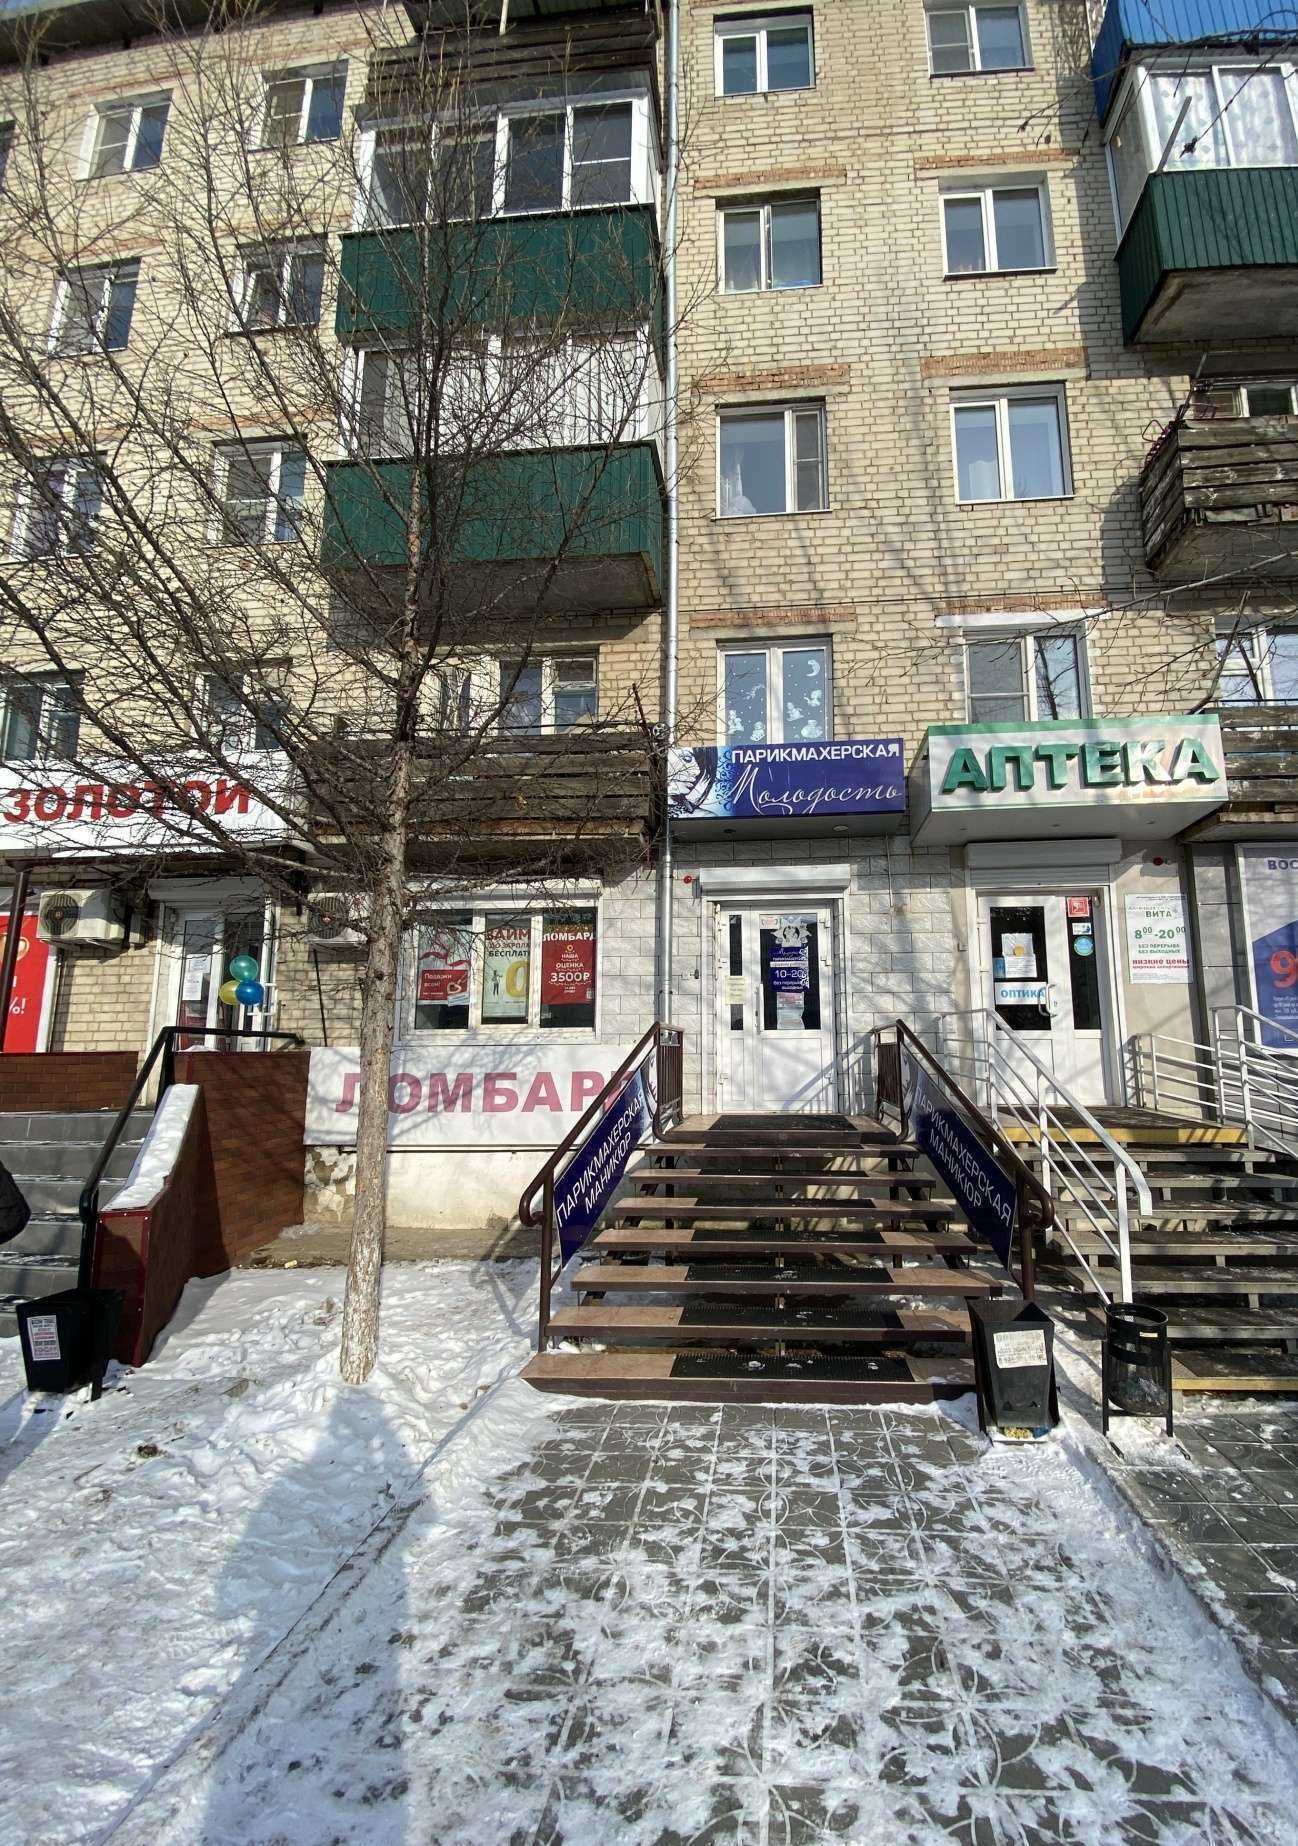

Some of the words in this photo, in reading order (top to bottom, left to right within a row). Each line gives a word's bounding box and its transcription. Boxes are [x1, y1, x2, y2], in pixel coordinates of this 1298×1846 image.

[732, 743, 900, 764] ПАРИКМАХЕРСКАЯ
[941, 737, 1220, 794] АПТЕКА
[730, 764, 902, 815] Молодость
[1145, 910, 1173, 918] ВИТА
[1000, 986, 1046, 999] ОПТИКА
[584, 1131, 631, 1215] МАНИКЮР
[914, 1087, 1012, 1226] ПАРИКМАХЕРСКАЯ
[929, 1128, 982, 1207] МАНИКЮР
